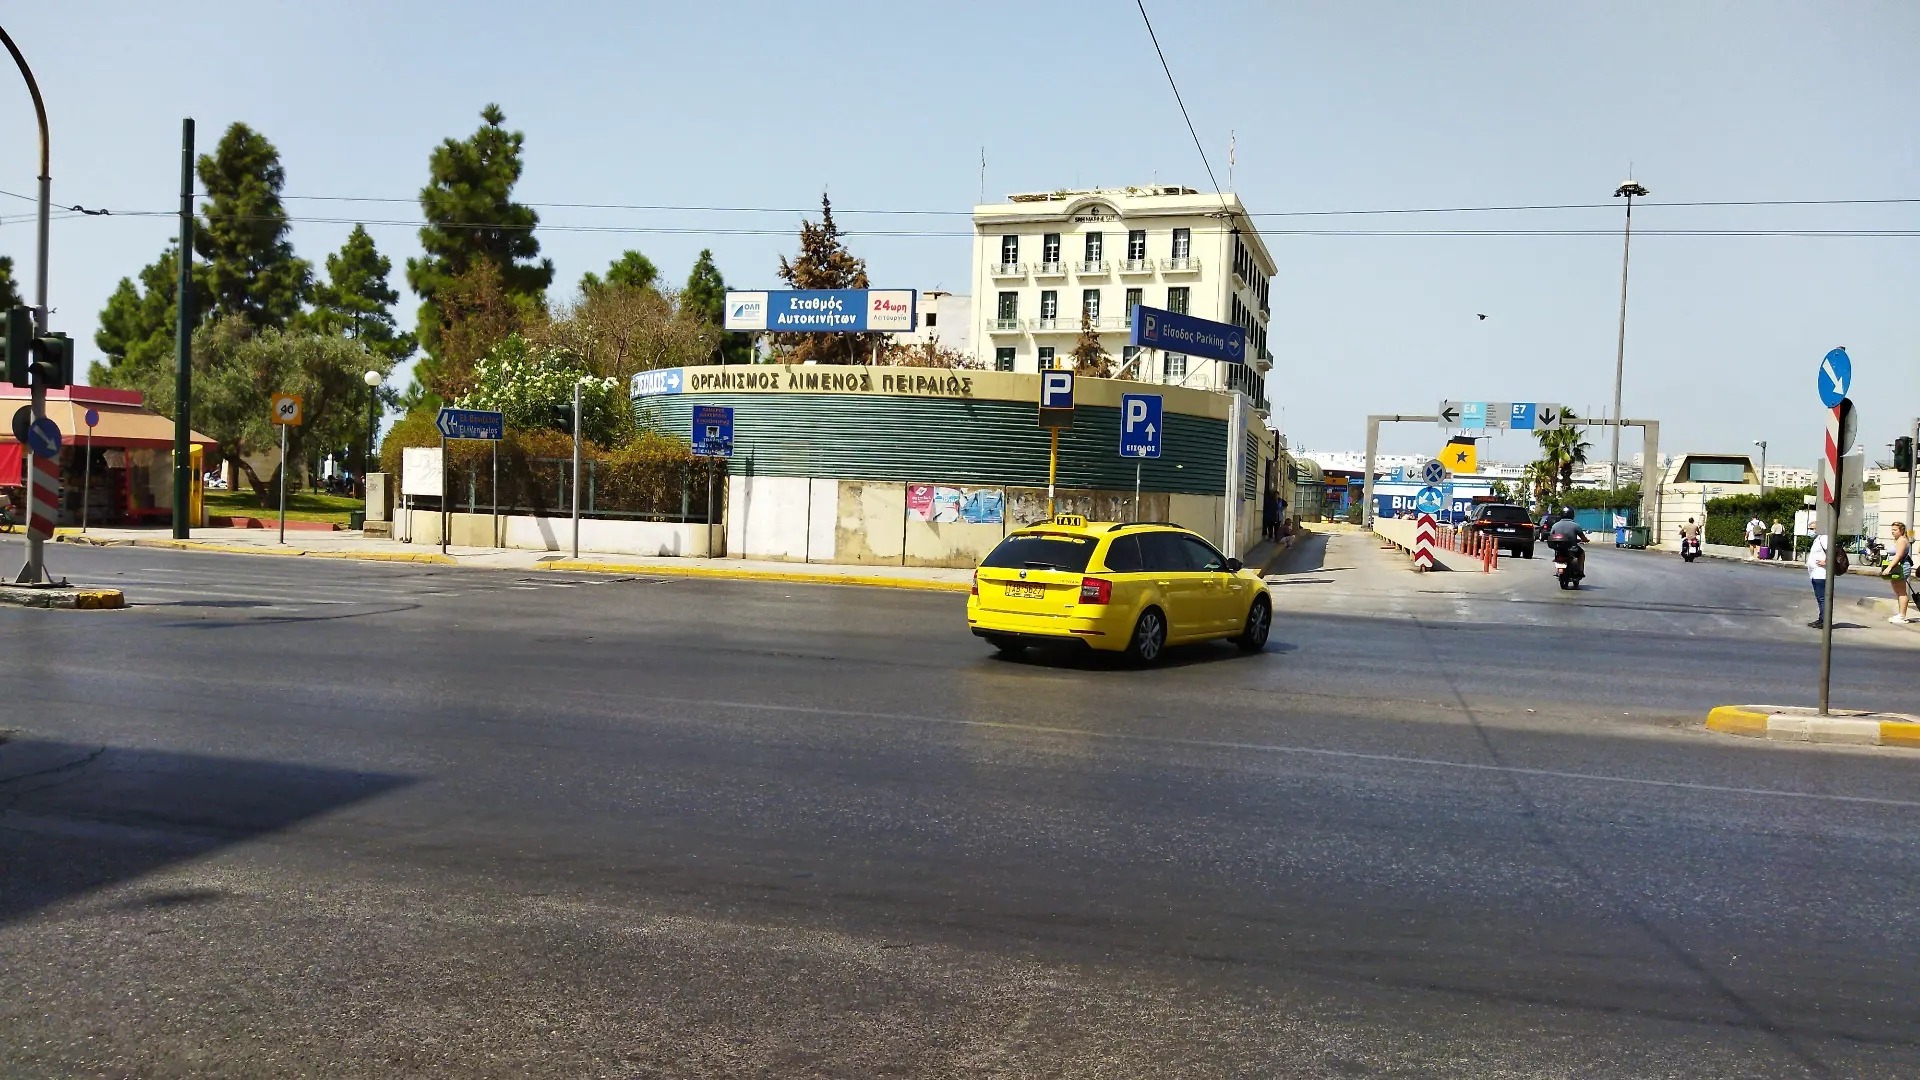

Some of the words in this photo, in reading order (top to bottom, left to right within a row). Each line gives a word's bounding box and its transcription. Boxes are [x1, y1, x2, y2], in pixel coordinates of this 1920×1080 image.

[789, 296, 844, 312] Σταθμός
[777, 311, 857, 327] Αυτοκινήτων
[1145, 316, 1156, 337] P
[1163, 323, 1194, 344] Είσοδος
[1196, 331, 1224, 350] Parking
[691, 372, 779, 391] ΟΡΓΑΝΙΣΜΟΣ
[788, 372, 871, 392] ΛΙΜΕΝΟΣ
[882, 374, 972, 397] ΠΕΙΡΑΙΩΣ
[1043, 373, 1071, 406] P
[280, 404, 294, 414] 40
[1126, 399, 1148, 433] P
[1512, 404, 1527, 414] E7
[1392, 496, 1417, 510] Blu
[1057, 516, 1080, 526] TAXI
